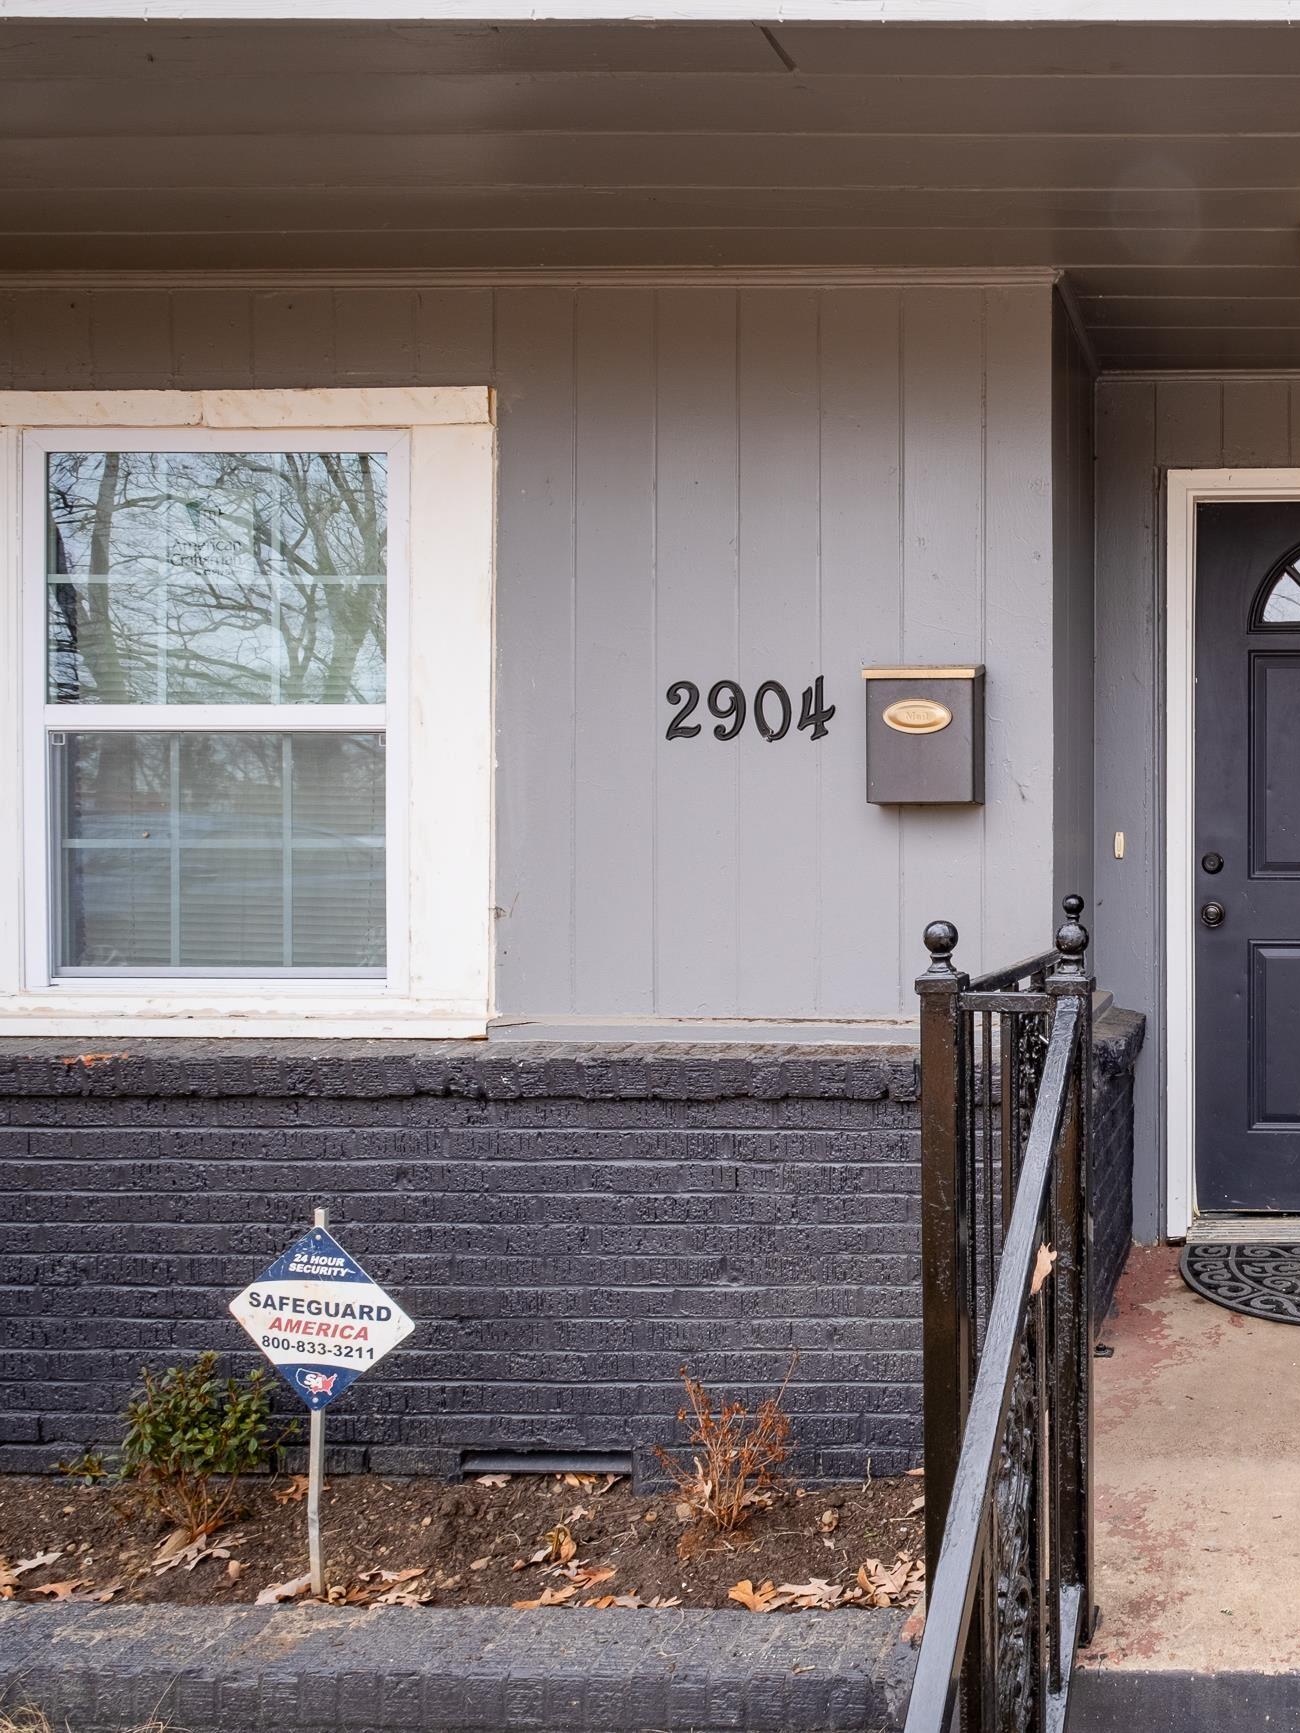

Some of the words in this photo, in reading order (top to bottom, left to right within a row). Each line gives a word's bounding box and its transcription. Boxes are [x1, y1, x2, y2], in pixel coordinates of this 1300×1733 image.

[666, 675, 836, 742] 2904
[905, 711, 929, 722] Mail
[288, 1263, 348, 1277] SECURITY
[293, 1254, 308, 1264] 24
[310, 1255, 345, 1267] HOUR
[249, 1292, 392, 1322] SAFEGUARD
[268, 1317, 369, 1341] AMERICA
[261, 1335, 375, 1360] 800-833-3211
